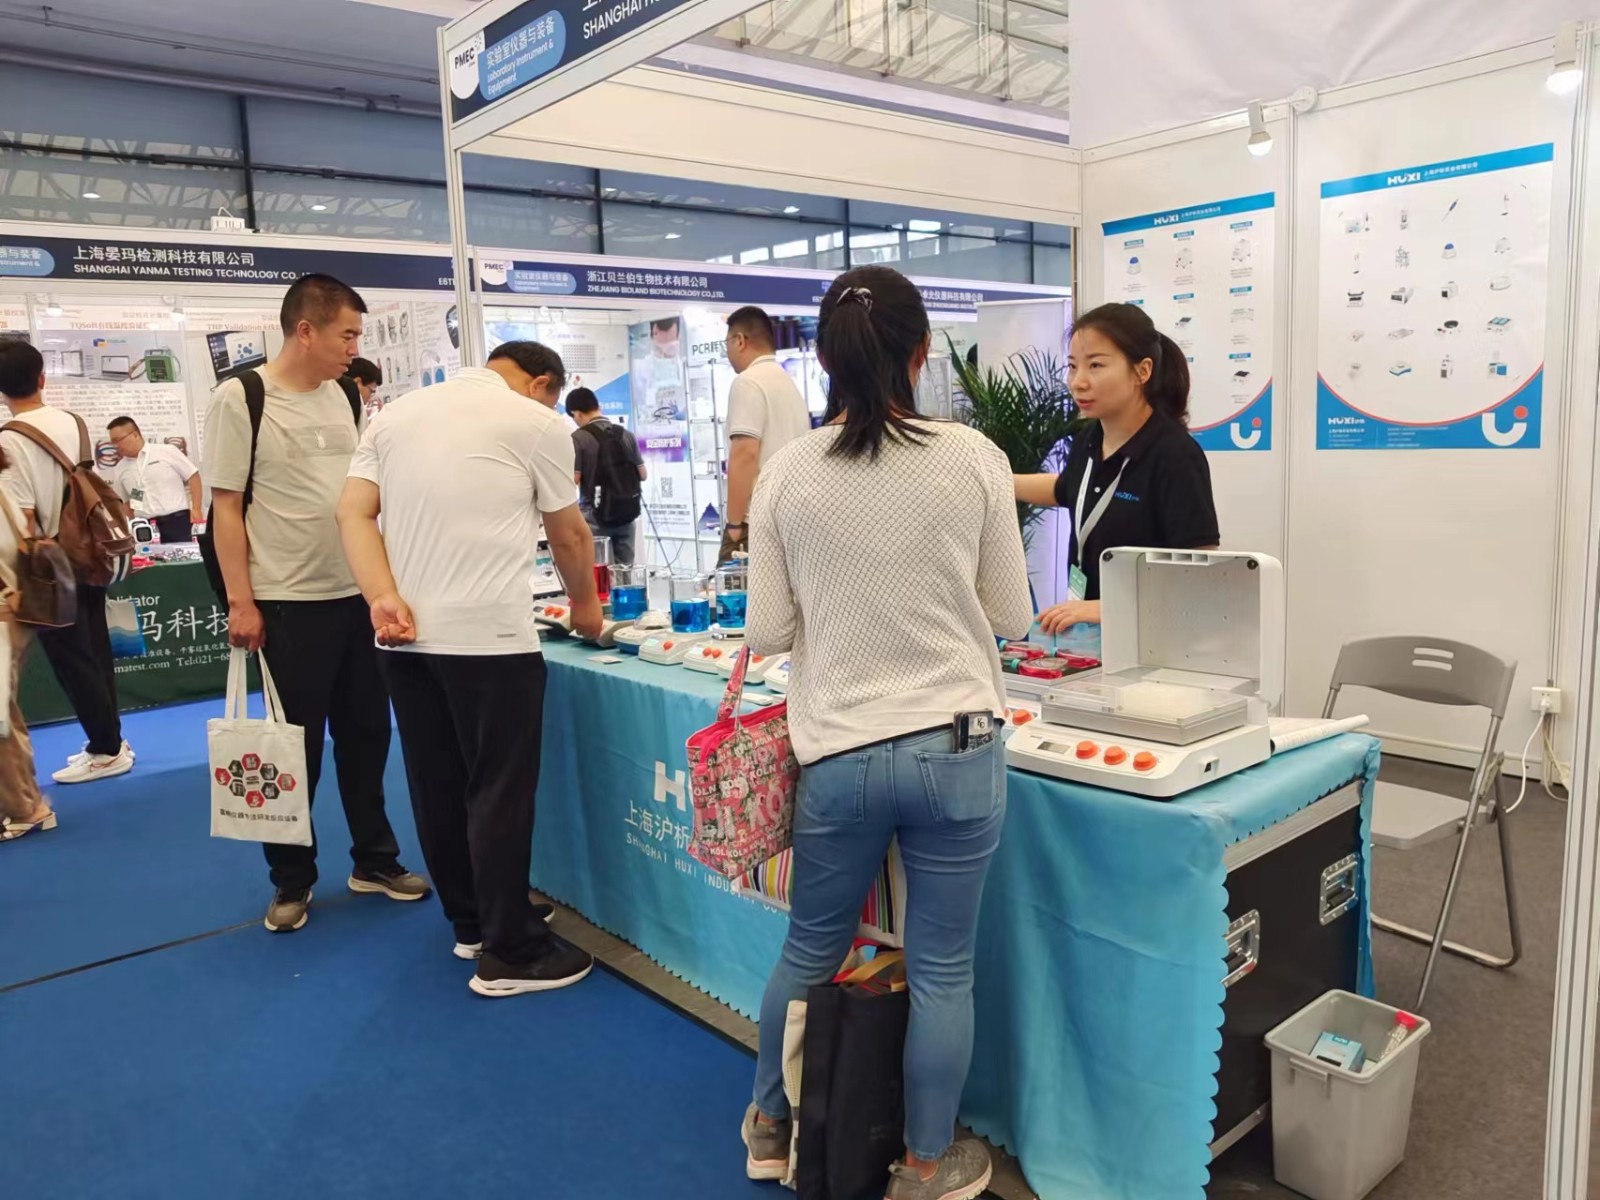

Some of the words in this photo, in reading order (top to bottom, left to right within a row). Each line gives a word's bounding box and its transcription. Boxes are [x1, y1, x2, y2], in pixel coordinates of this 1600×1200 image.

[486, 16, 555, 69] 实验室仪器与装备
[455, 47, 475, 69] PMEC
[487, 61, 516, 83] Laboratory
[488, 72, 517, 96] Equipment
[1387, 172, 1421, 186] HUXI
[1154, 214, 1179, 225] HUXI
[73, 245, 255, 266] 上海晏玛检测科技有限公司
[74, 264, 131, 275] SHANGHAI
[133, 265, 170, 275] YANMA
[172, 267, 213, 277] TESTING
[216, 268, 279, 279] TECHNOLOGY
[587, 270, 708, 288] 浙江贝兰伯生物技术有限公司
[587, 285, 620, 293] ZHEJIANG
[621, 286, 649, 295] BIOLAND
[649, 287, 700, 297] BIOTECHNOLOGY
[674, 858, 697, 878] HUXI
